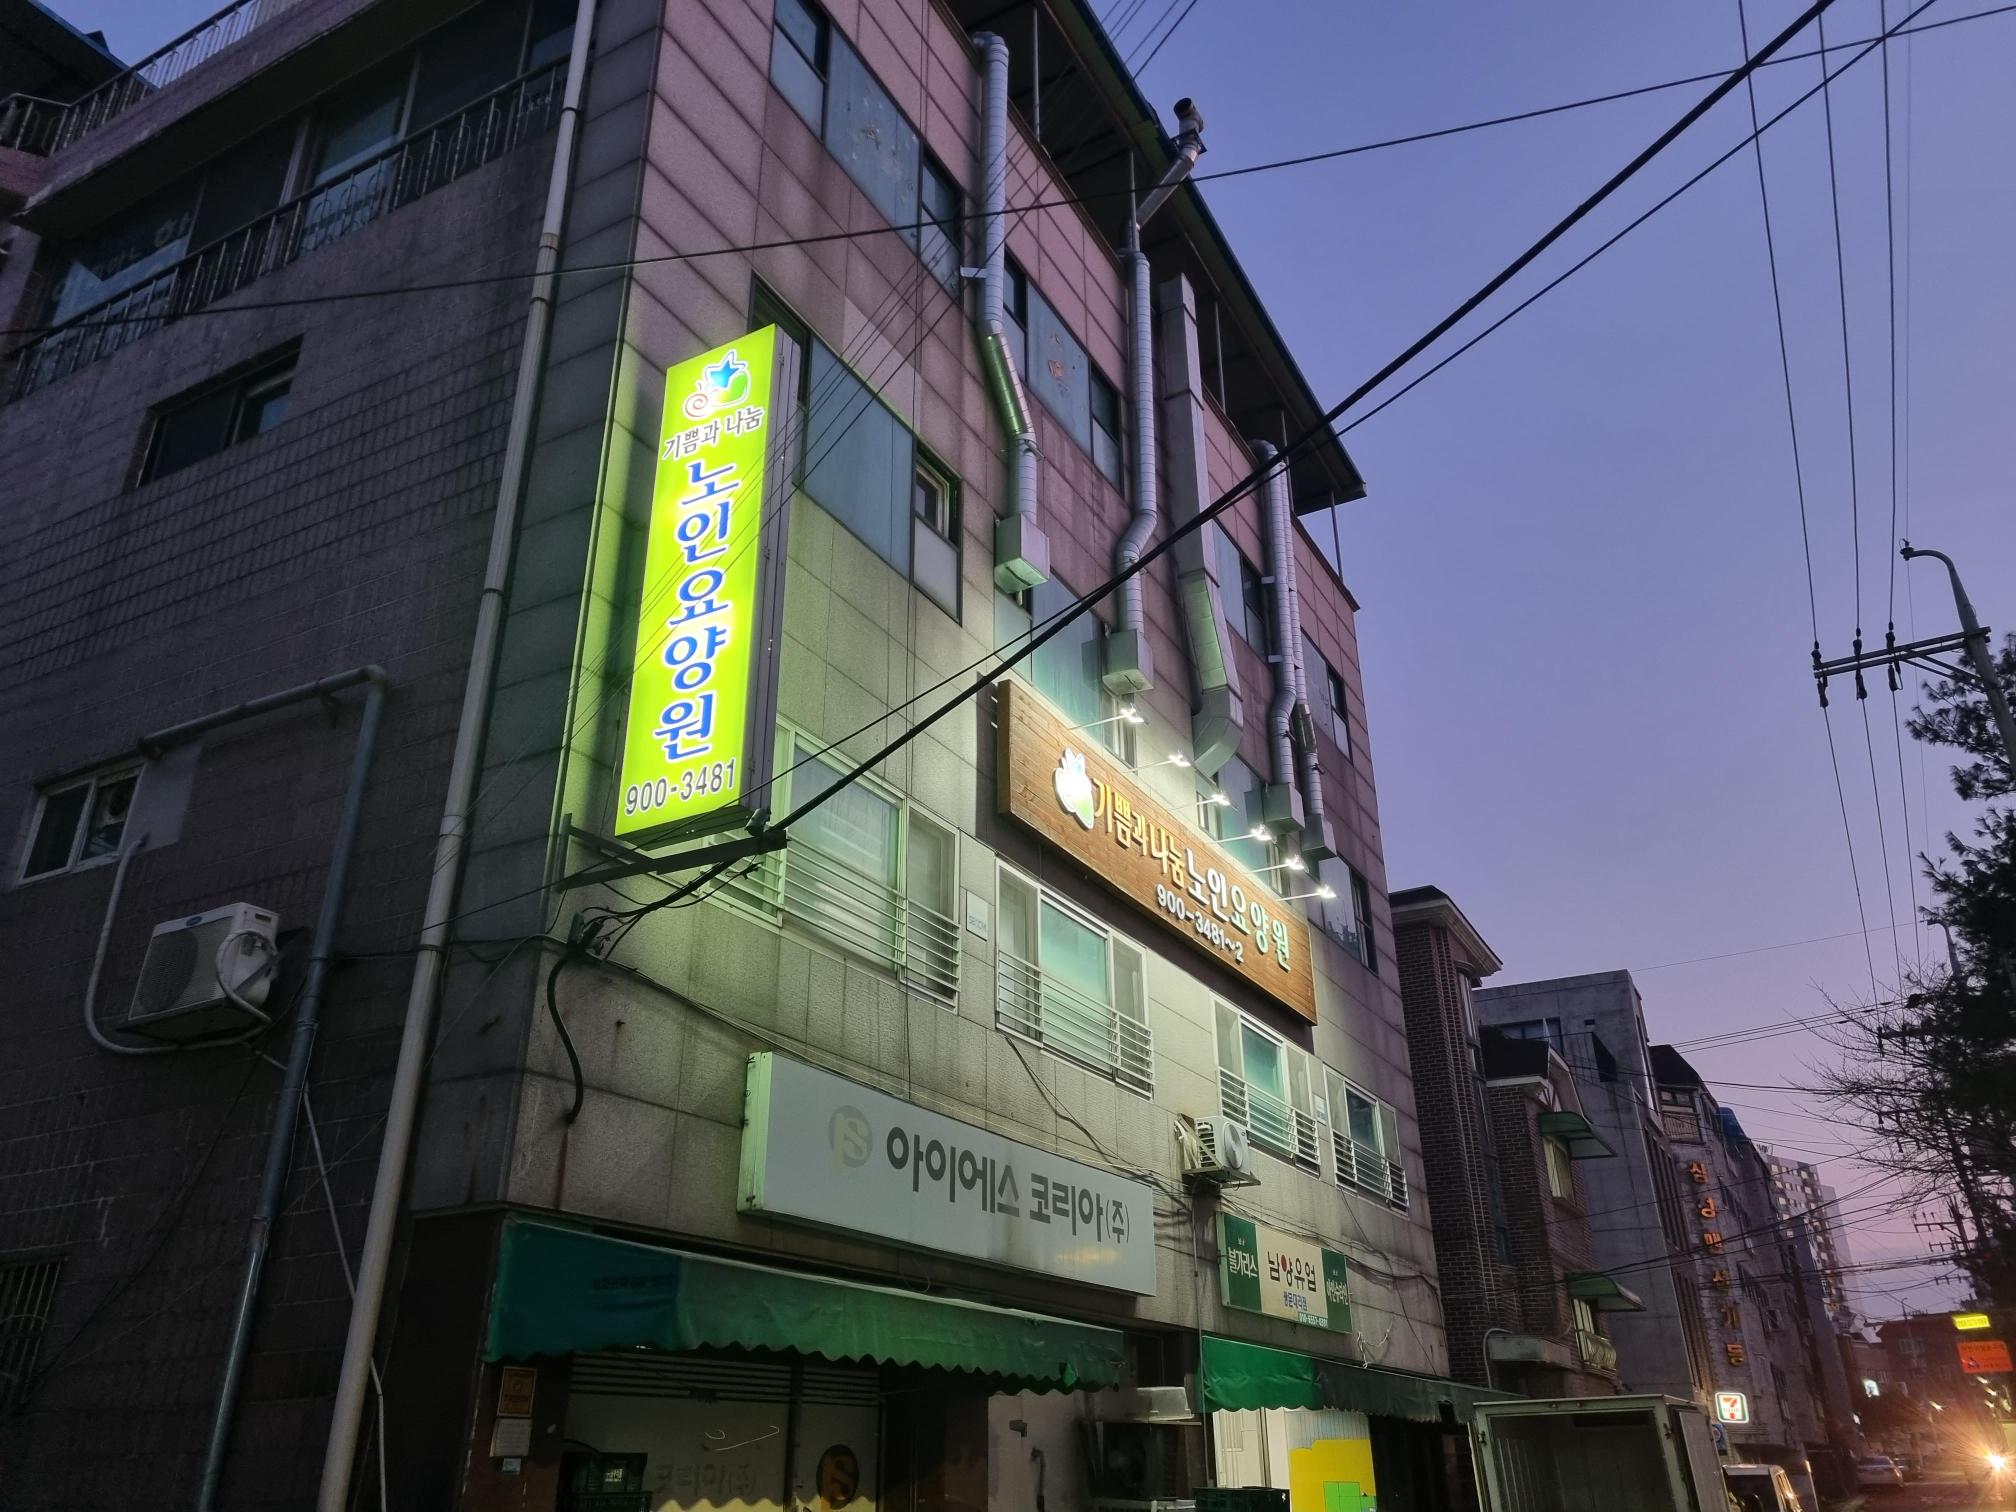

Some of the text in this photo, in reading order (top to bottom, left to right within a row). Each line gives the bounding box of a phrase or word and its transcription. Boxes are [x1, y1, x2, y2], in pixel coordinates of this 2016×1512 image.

[662, 407, 764, 461] 기쁨과 나눔
[653, 460, 741, 762] 노인요양원
[624, 757, 738, 817] 900-3481
[1156, 883, 1245, 965] 900-3481~2
[1186, 847, 1291, 973] 노인요양원
[886, 1126, 1020, 1217] 아이에스
[1227, 1246, 1259, 1279] 불가리스
[1266, 1251, 1318, 1293] 남양유업
